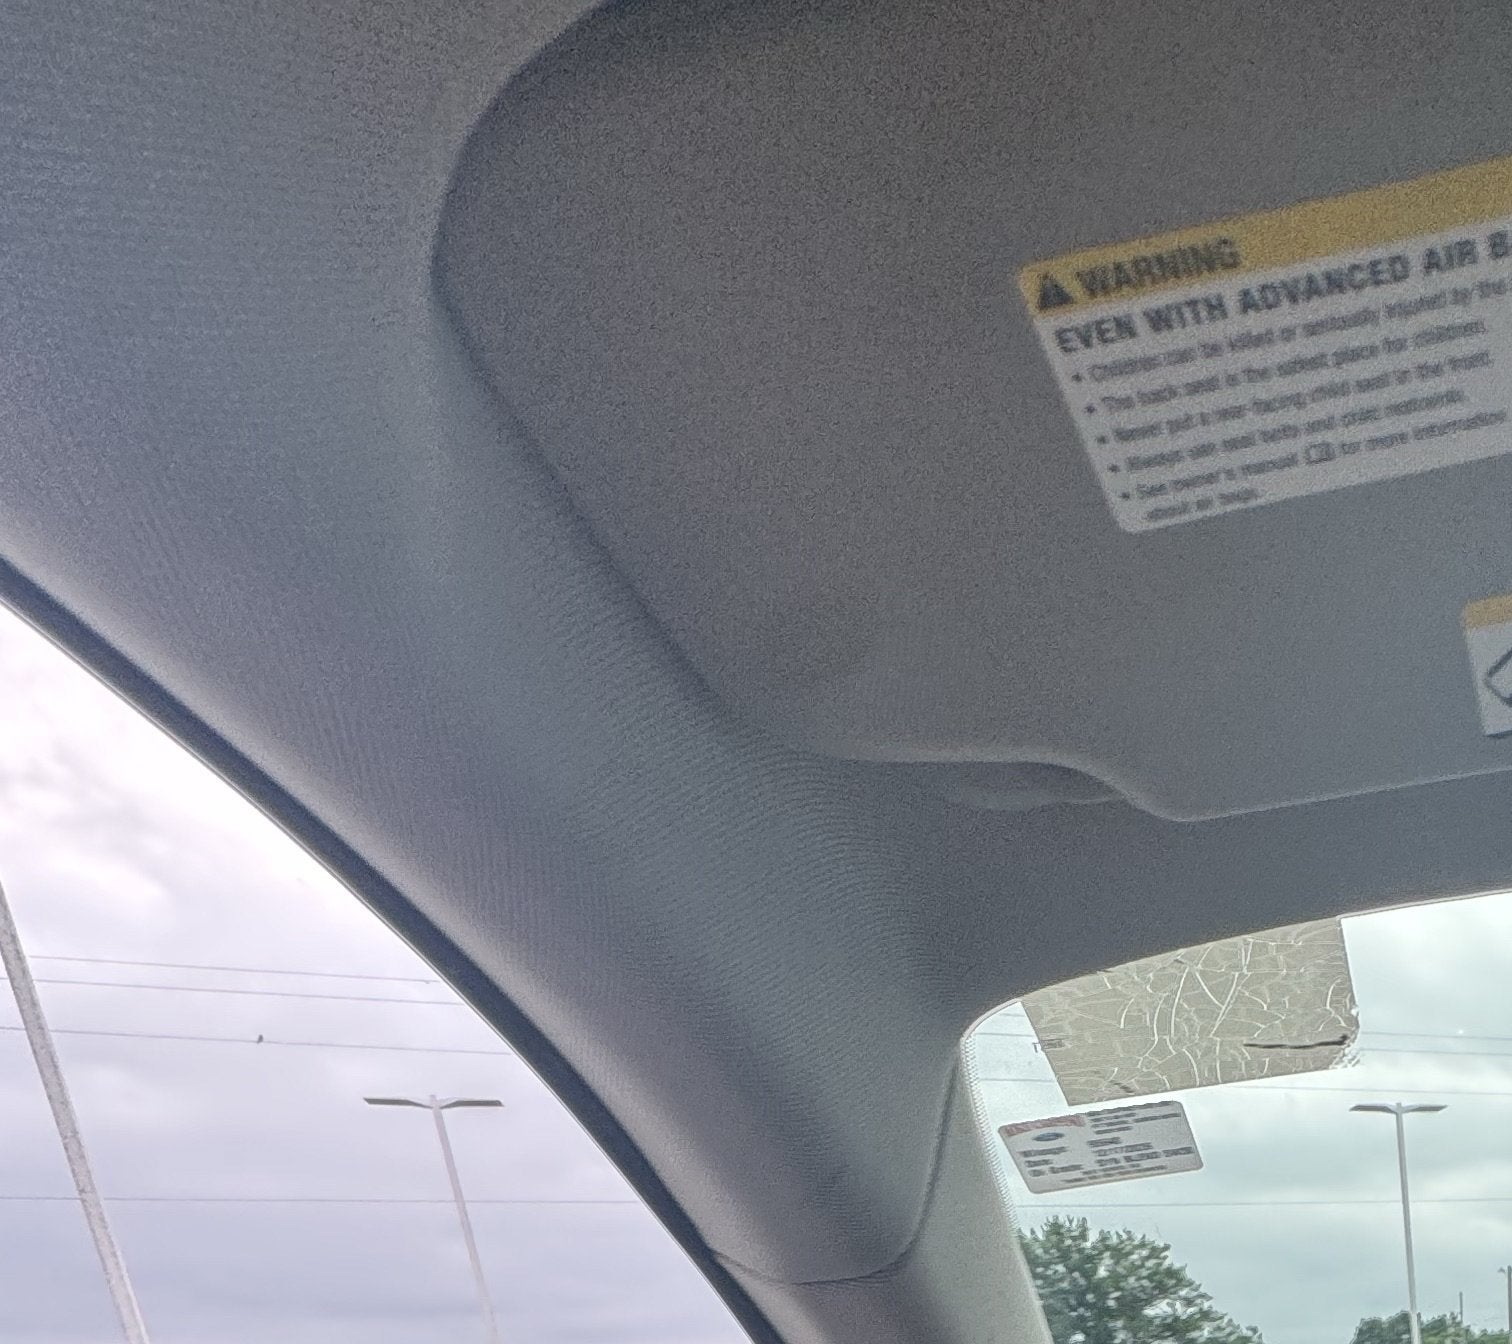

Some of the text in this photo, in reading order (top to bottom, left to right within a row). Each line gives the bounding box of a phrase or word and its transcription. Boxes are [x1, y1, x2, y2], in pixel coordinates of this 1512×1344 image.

[1055, 314, 1137, 352] EVEN
[1143, 293, 1228, 332] WITH
[1239, 254, 1409, 314] ADVANCED
[1424, 239, 1478, 276] AIR
[1076, 238, 1241, 298] WARNING
